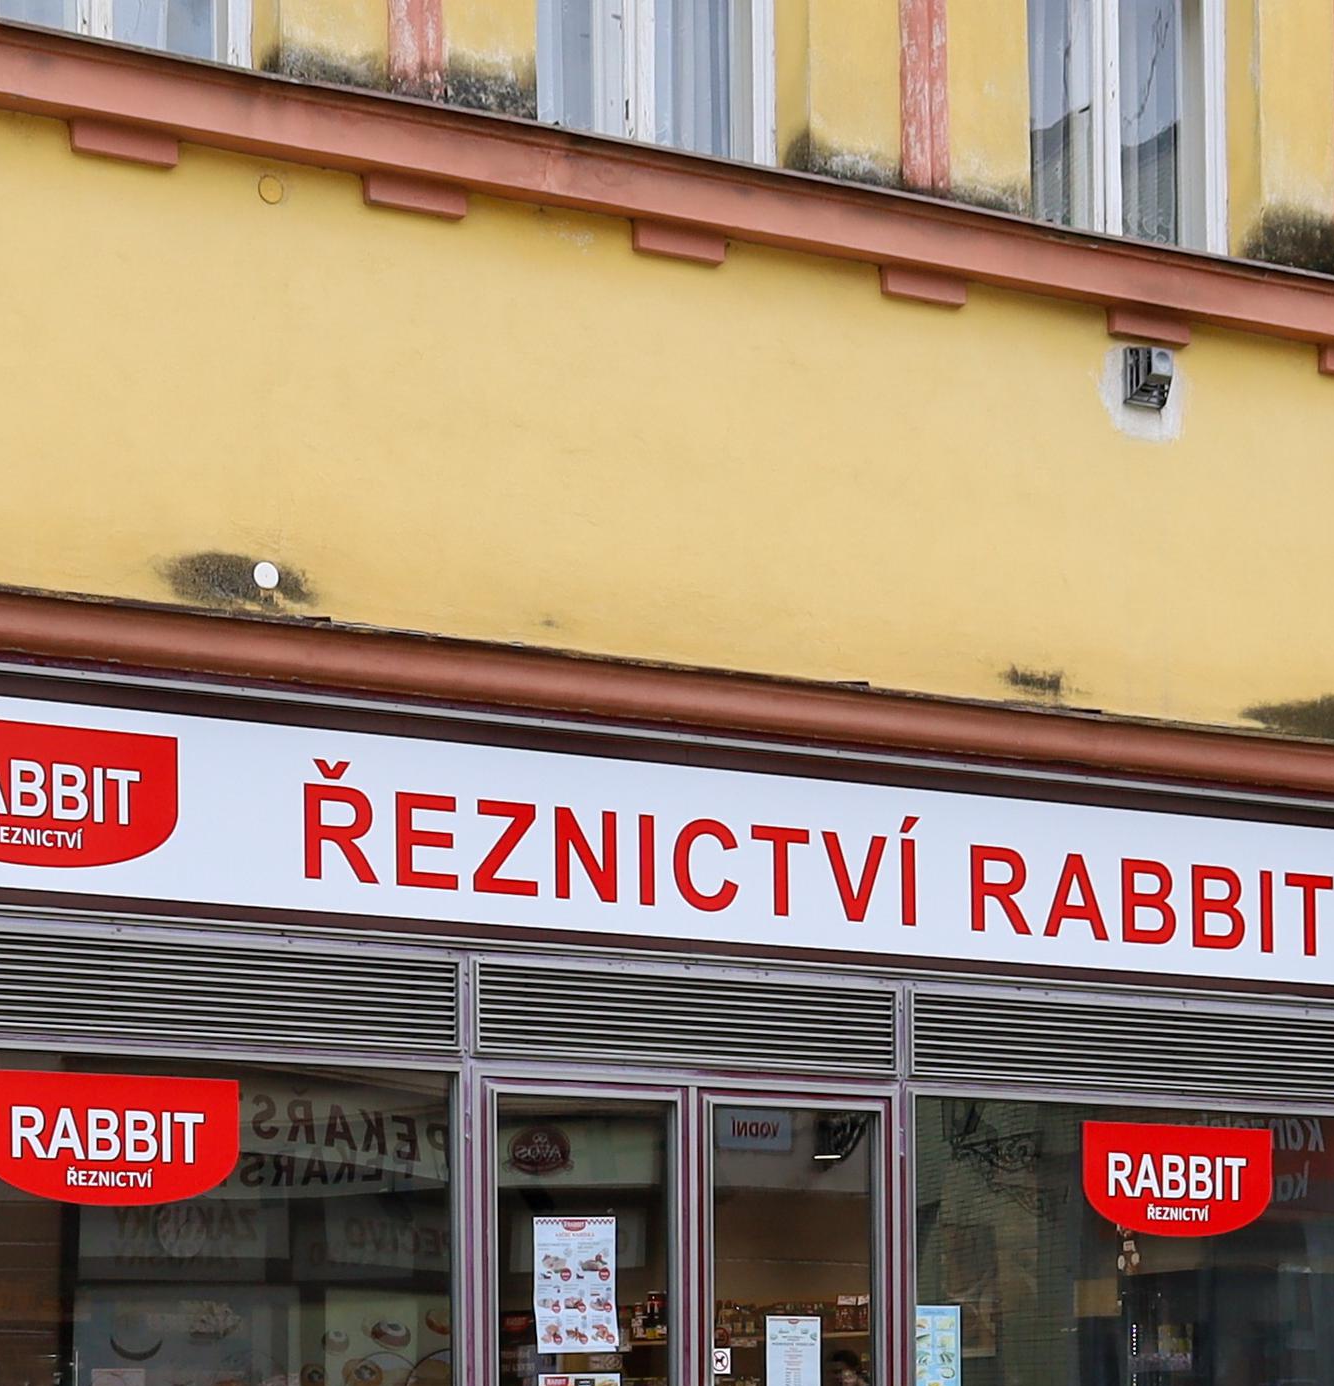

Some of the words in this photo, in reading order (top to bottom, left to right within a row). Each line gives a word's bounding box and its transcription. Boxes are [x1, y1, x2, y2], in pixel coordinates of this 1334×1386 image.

[302, 758, 918, 927] ŘEZNICTVÍ
[969, 844, 1334, 957] RABBIT
[10, 1105, 205, 1164] RABBIT
[66, 1166, 153, 1188] ŘEZNICTVÍ
[1107, 1151, 1247, 1201] RABBIT
[1146, 1203, 1209, 1222] ŘEZNICTVÍ
